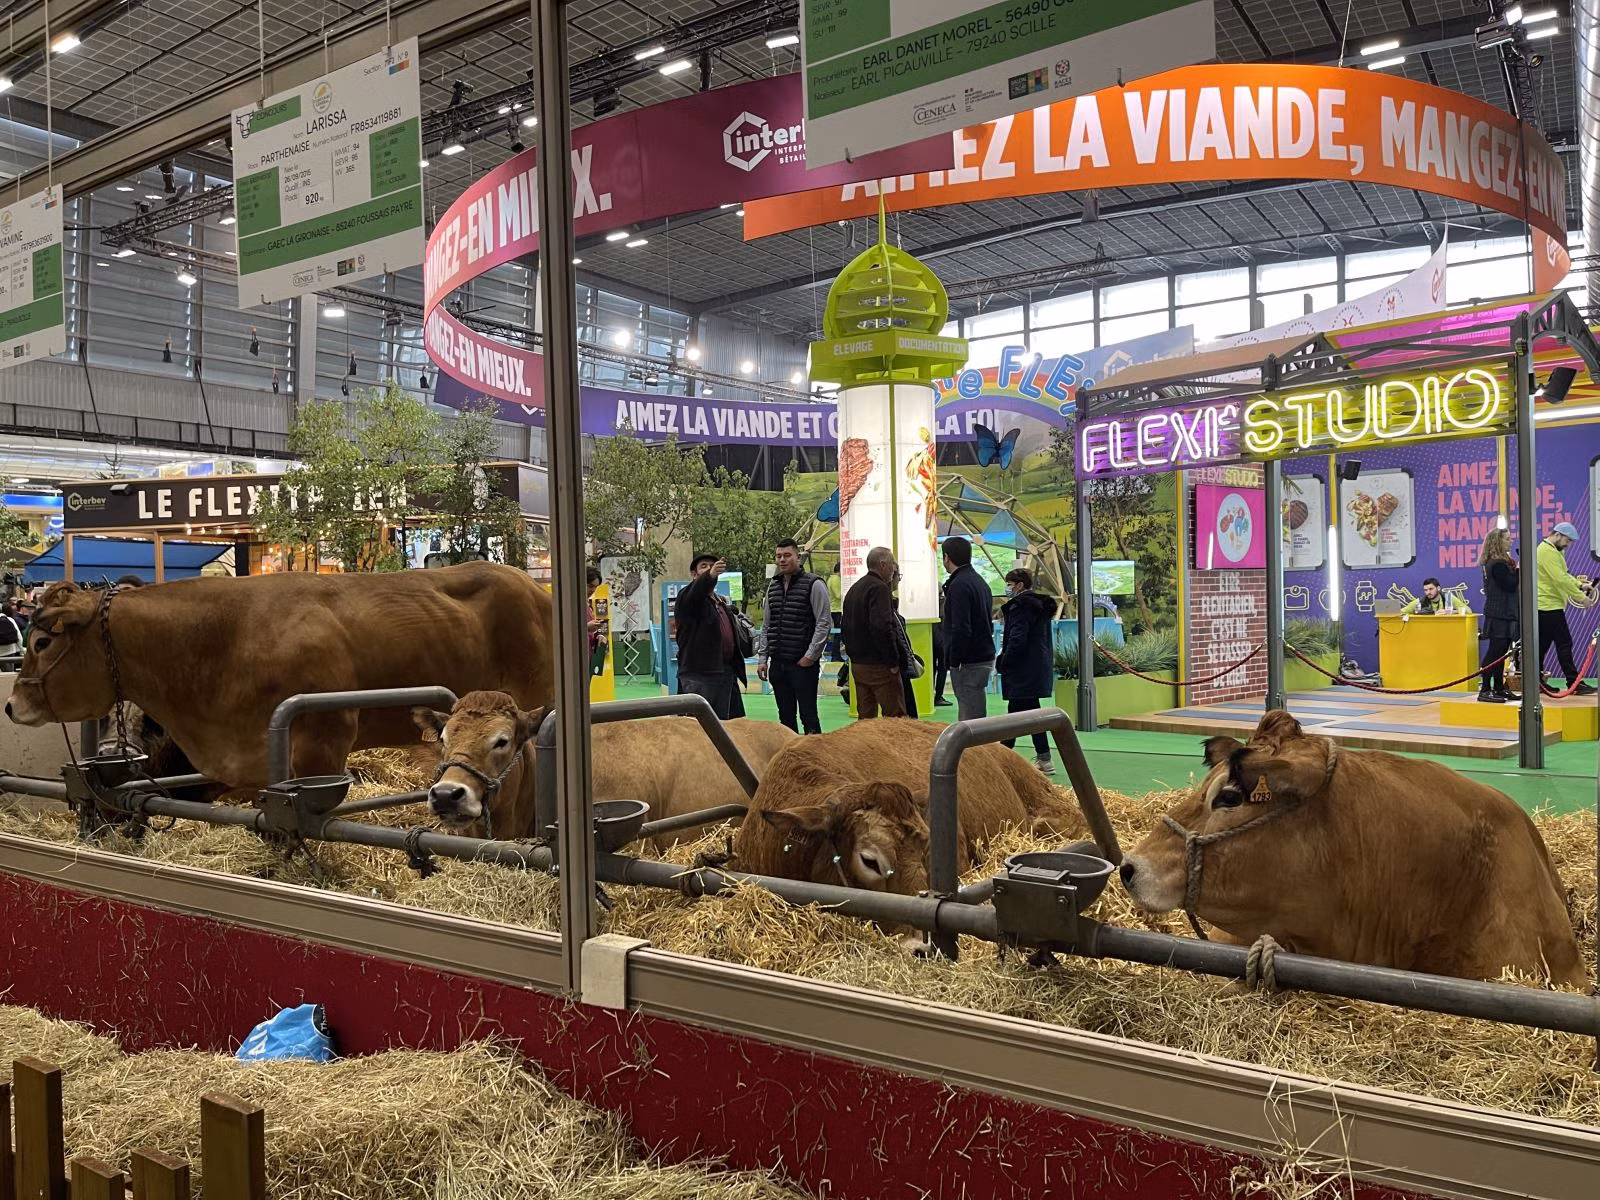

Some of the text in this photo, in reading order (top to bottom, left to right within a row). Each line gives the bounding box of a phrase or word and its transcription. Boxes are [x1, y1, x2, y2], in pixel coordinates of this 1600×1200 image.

[863, 51, 892, 70] EARL
[896, 34, 940, 59] DANET
[943, 17, 992, 43] MOREL
[1006, 0, 1049, 22] 56490
[852, 73, 880, 90] EARL
[884, 46, 953, 77] PICAUVILLE
[966, 30, 1006, 54] 79240
[1010, 13, 1056, 39] SCILLE
[256, 103, 287, 121] CONCOURS
[306, 108, 347, 135] LARISSA
[350, 107, 402, 135] FR8534119881
[914, 103, 956, 124] CENECA
[260, 140, 310, 166] PARTHENAISE
[1033, 95, 1110, 174] LA
[1123, 87, 1364, 175] VIANDE,
[1381, 96, 1549, 218] MANGEZ-EN
[305, 192, 319, 205] 920
[498, 144, 612, 248] MIX.
[267, 234, 286, 251] GAEC
[286, 231, 294, 246] LA
[356, 208, 390, 226] FOUSSAIS
[390, 199, 413, 217] PAYRE
[899, 337, 967, 355] DOCUMENTATION
[477, 343, 532, 397] MIEUX.
[615, 399, 679, 433] AIMEZ
[683, 405, 710, 436] LA
[712, 408, 794, 439] VIANDE
[797, 412, 822, 439] ET
[965, 408, 1001, 436] FO
[1244, 368, 1502, 453] STUDIO
[71, 495, 107, 506] interbev
[138, 489, 172, 519] LE
[1438, 491, 1465, 514] LA
